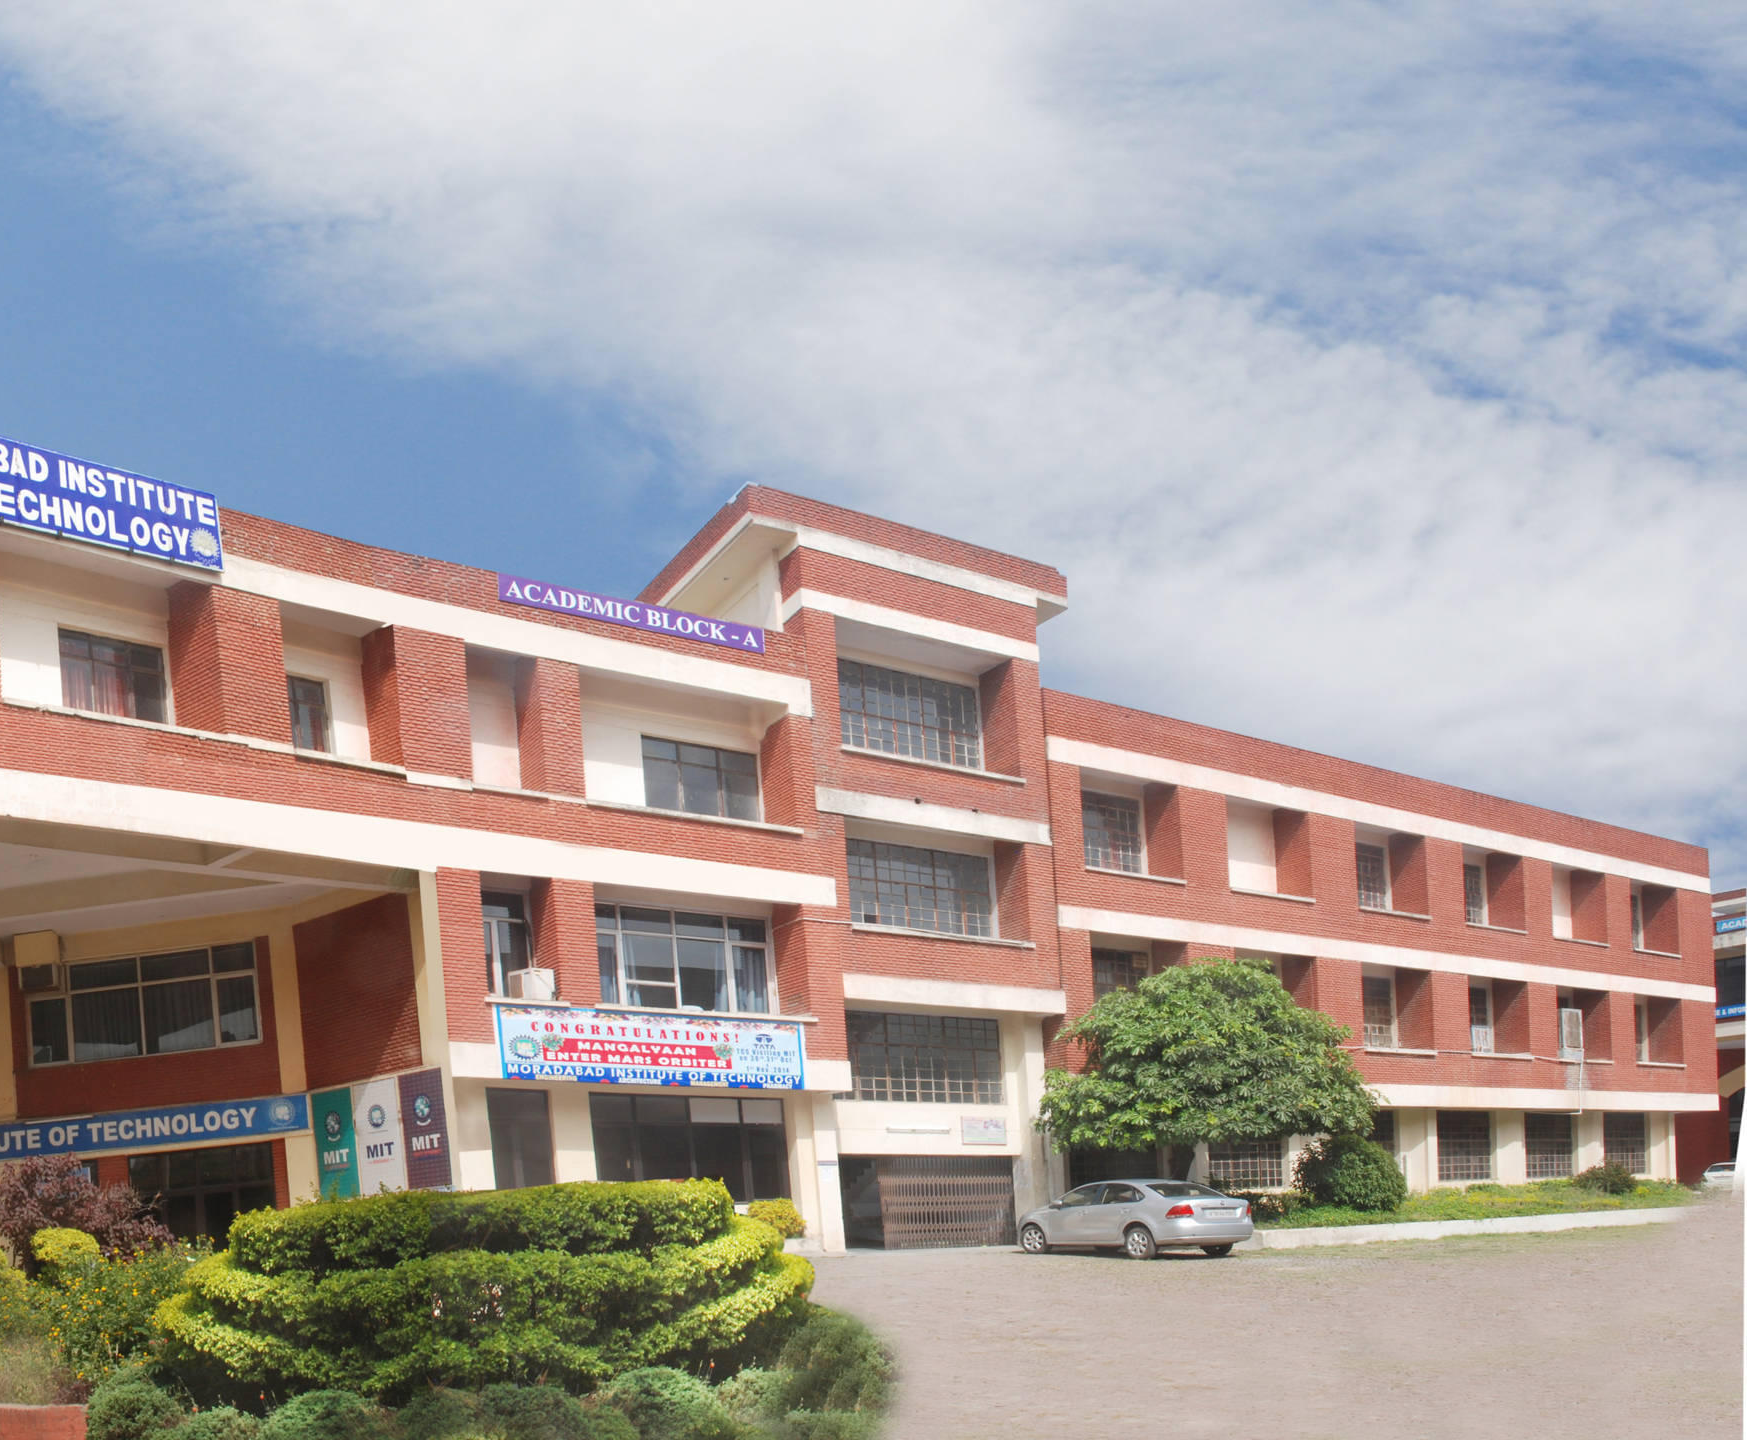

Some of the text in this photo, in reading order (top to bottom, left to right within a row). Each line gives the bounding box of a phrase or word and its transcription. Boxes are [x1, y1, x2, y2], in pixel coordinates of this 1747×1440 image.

[59, 460, 216, 526] INSTITUTE
[506, 581, 640, 623] ACADEMIC
[646, 609, 727, 642] BLOCK
[743, 631, 758, 648] A
[577, 1041, 697, 1056] MANGALYAAN
[546, 1051, 727, 1069] ENTER MARS ORBITER
[507, 1063, 801, 1085] MORADABAD INSTITUTE OF TECHNOLOGY
[48, 1125, 79, 1147] OF
[86, 1107, 256, 1143] TECHNOLOGY
[366, 1141, 394, 1159] MIT
[411, 1133, 441, 1151] MIT
[323, 1148, 350, 1165] MIT
